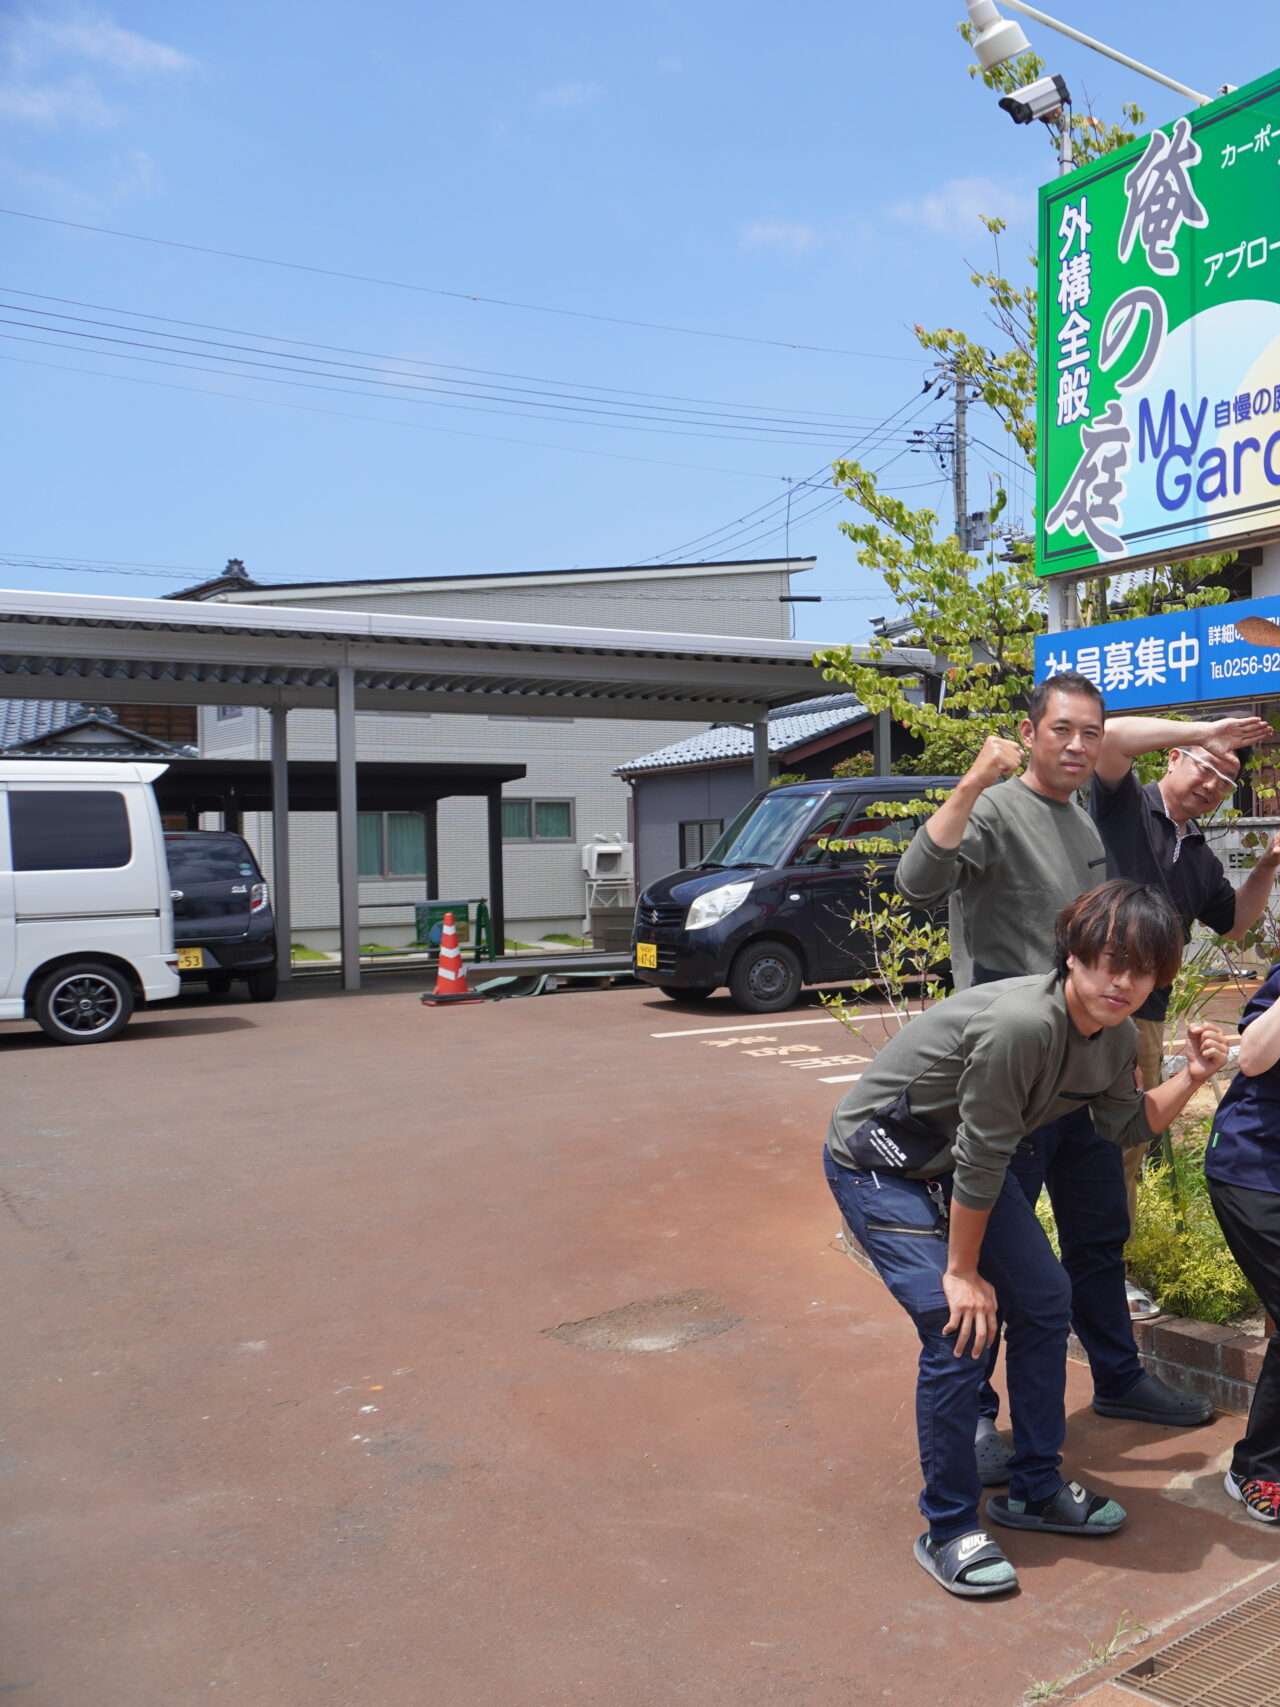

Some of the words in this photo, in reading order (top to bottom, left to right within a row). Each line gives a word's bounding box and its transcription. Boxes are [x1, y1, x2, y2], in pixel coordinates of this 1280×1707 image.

[1056, 196, 1092, 428] 外構全般
[1138, 388, 1209, 464] My
[960, 1533, 988, 1553] NIKE
